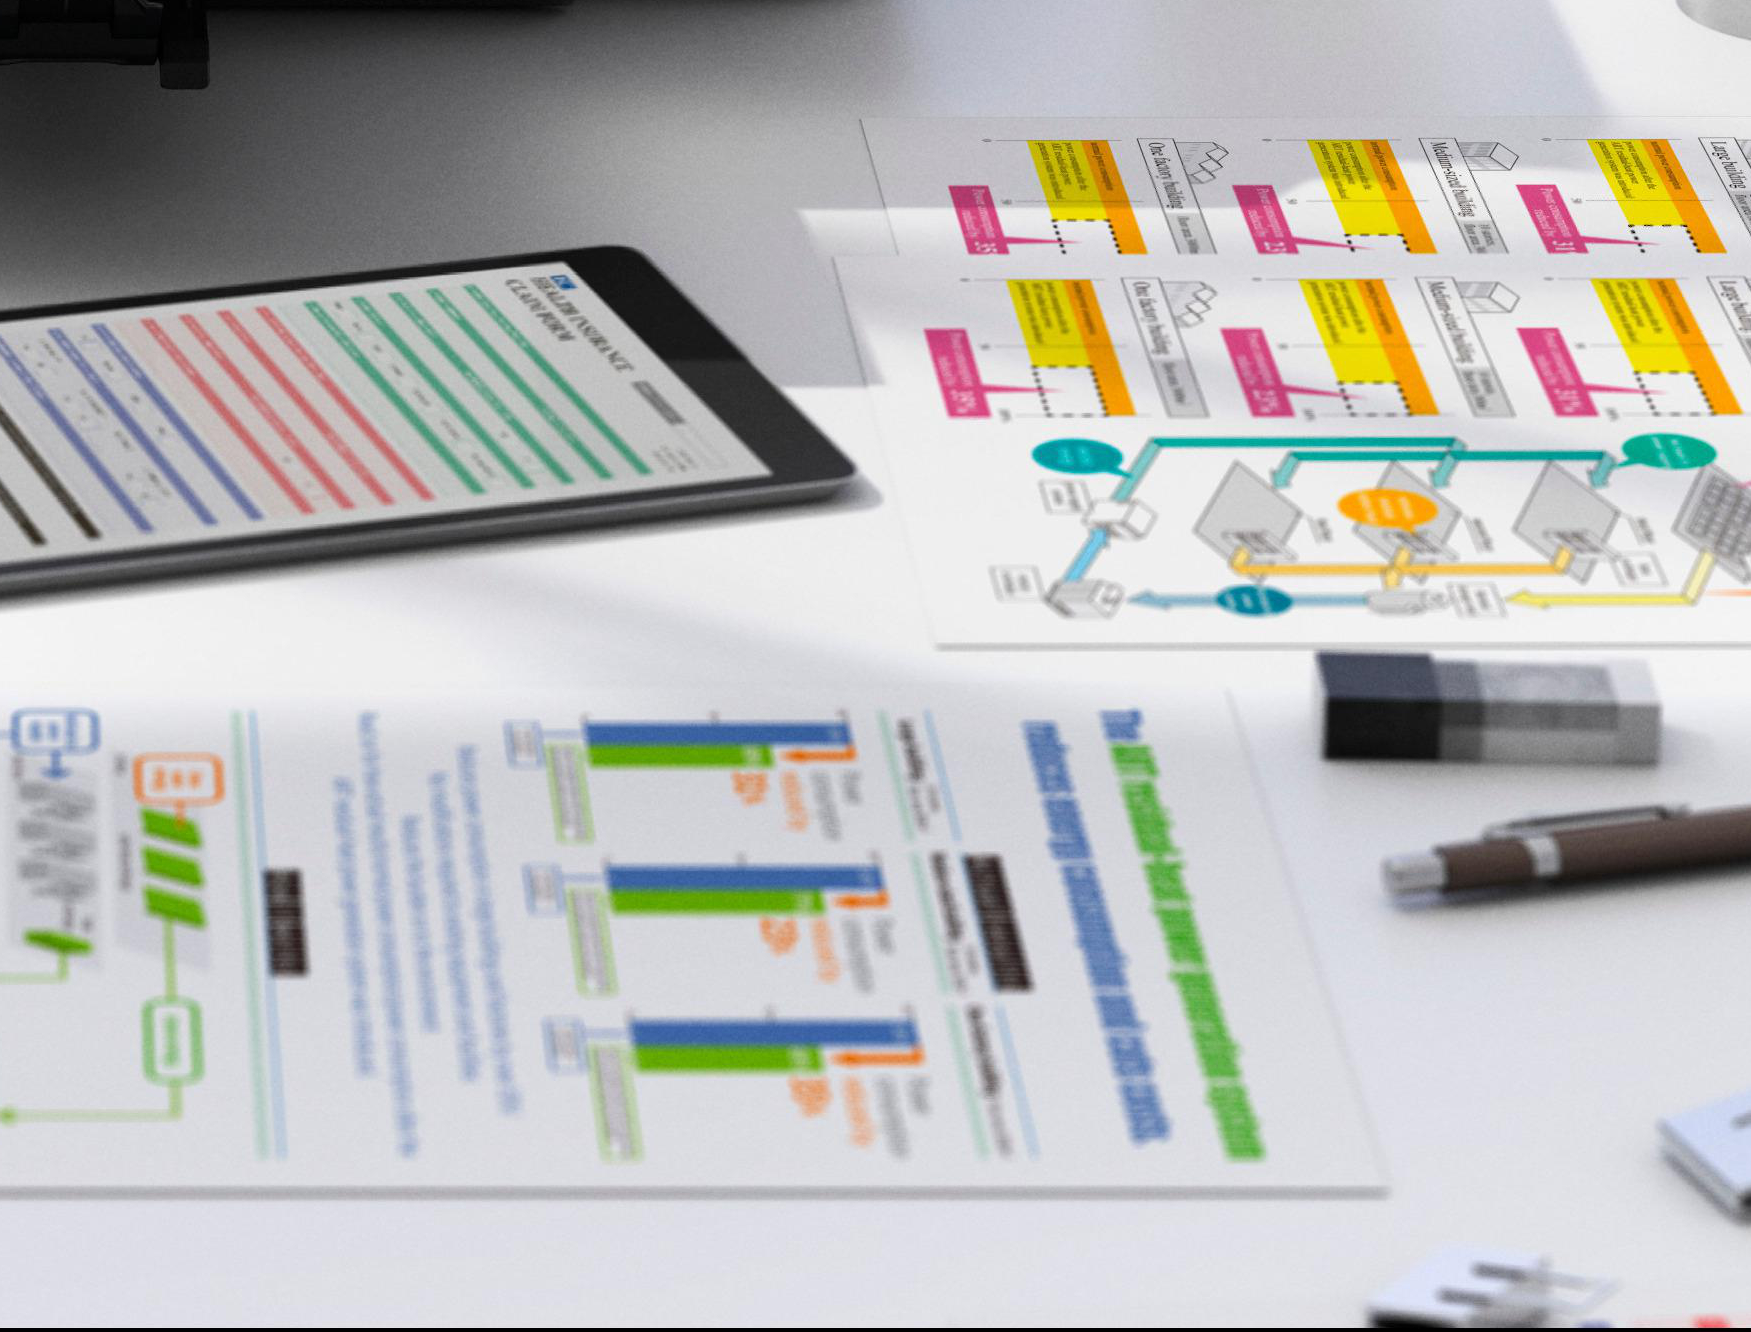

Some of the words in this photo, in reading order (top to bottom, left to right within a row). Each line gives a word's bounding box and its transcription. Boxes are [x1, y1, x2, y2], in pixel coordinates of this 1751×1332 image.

[1148, 142, 1166, 157] One
[1155, 157, 1173, 181] factory
[1430, 142, 1466, 189] Medium-sized
[1453, 189, 1477, 217] building
[1710, 141, 1730, 161] Large
[1721, 161, 1746, 190] building
[1162, 181, 1187, 210] building
